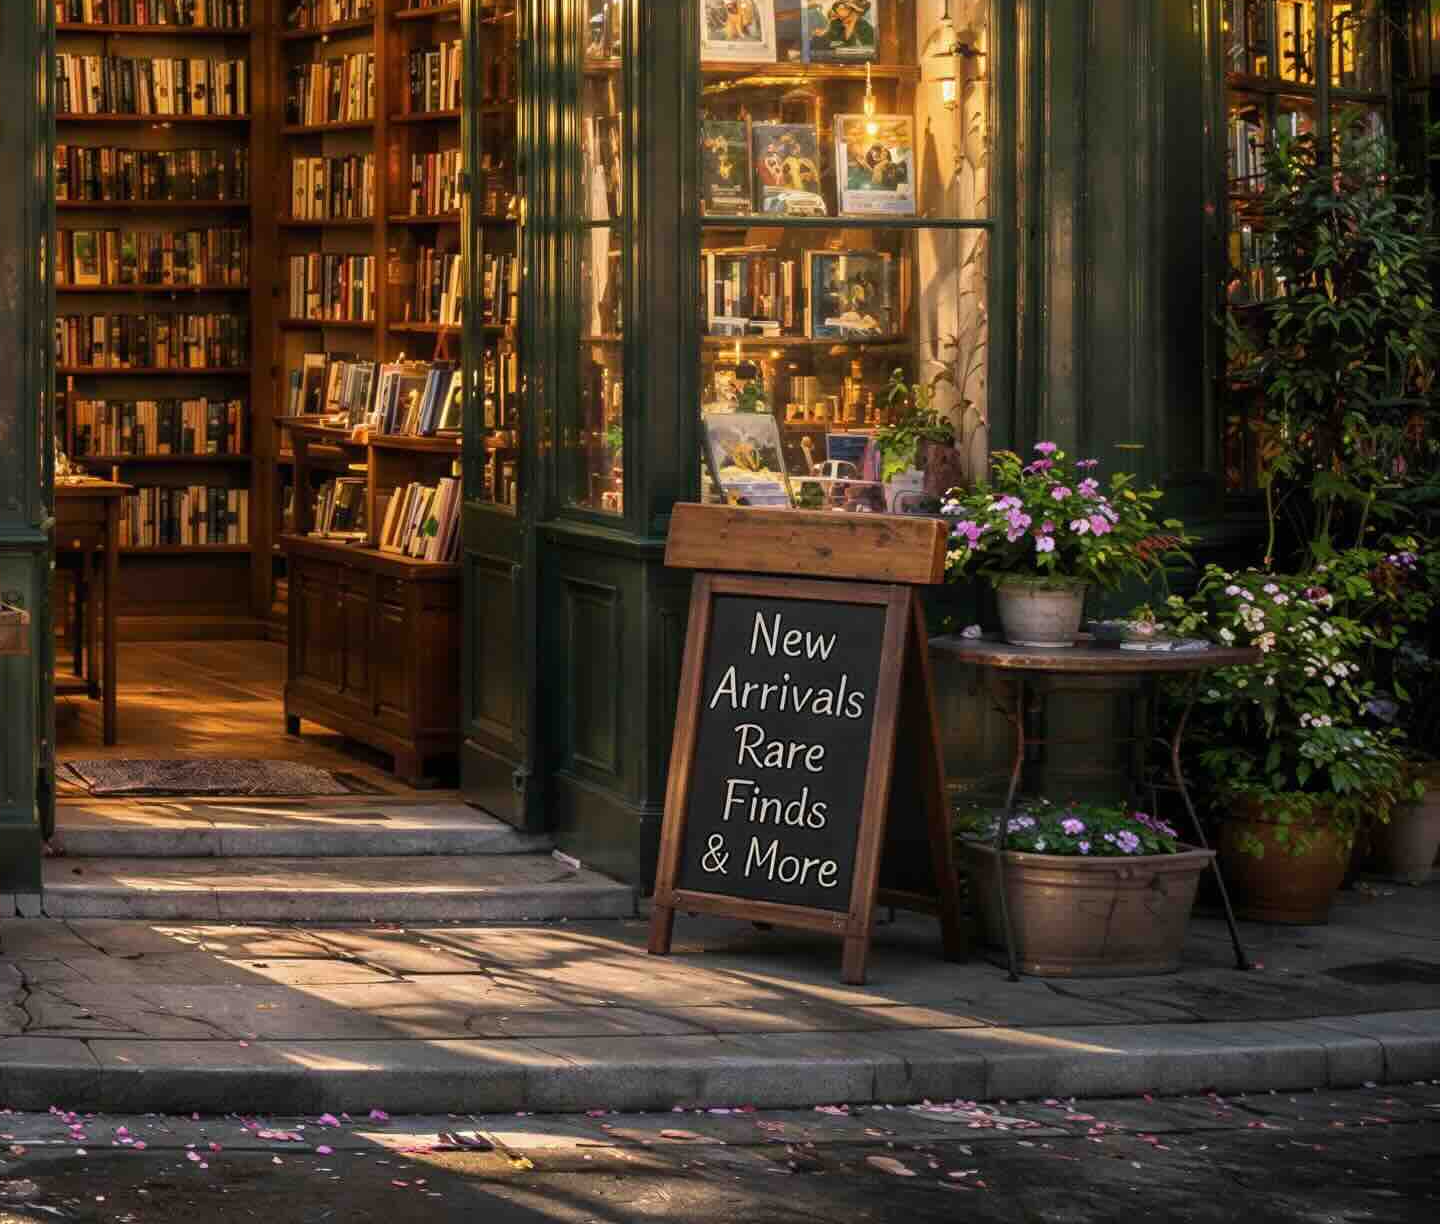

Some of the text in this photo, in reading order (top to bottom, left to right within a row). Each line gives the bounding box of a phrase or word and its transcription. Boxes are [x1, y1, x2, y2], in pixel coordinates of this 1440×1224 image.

[750, 611, 836, 661] New
[709, 665, 865, 718] Arrivals
[734, 723, 825, 772] Rare
[723, 778, 827, 829] Finds
[701, 833, 837, 888] & More
